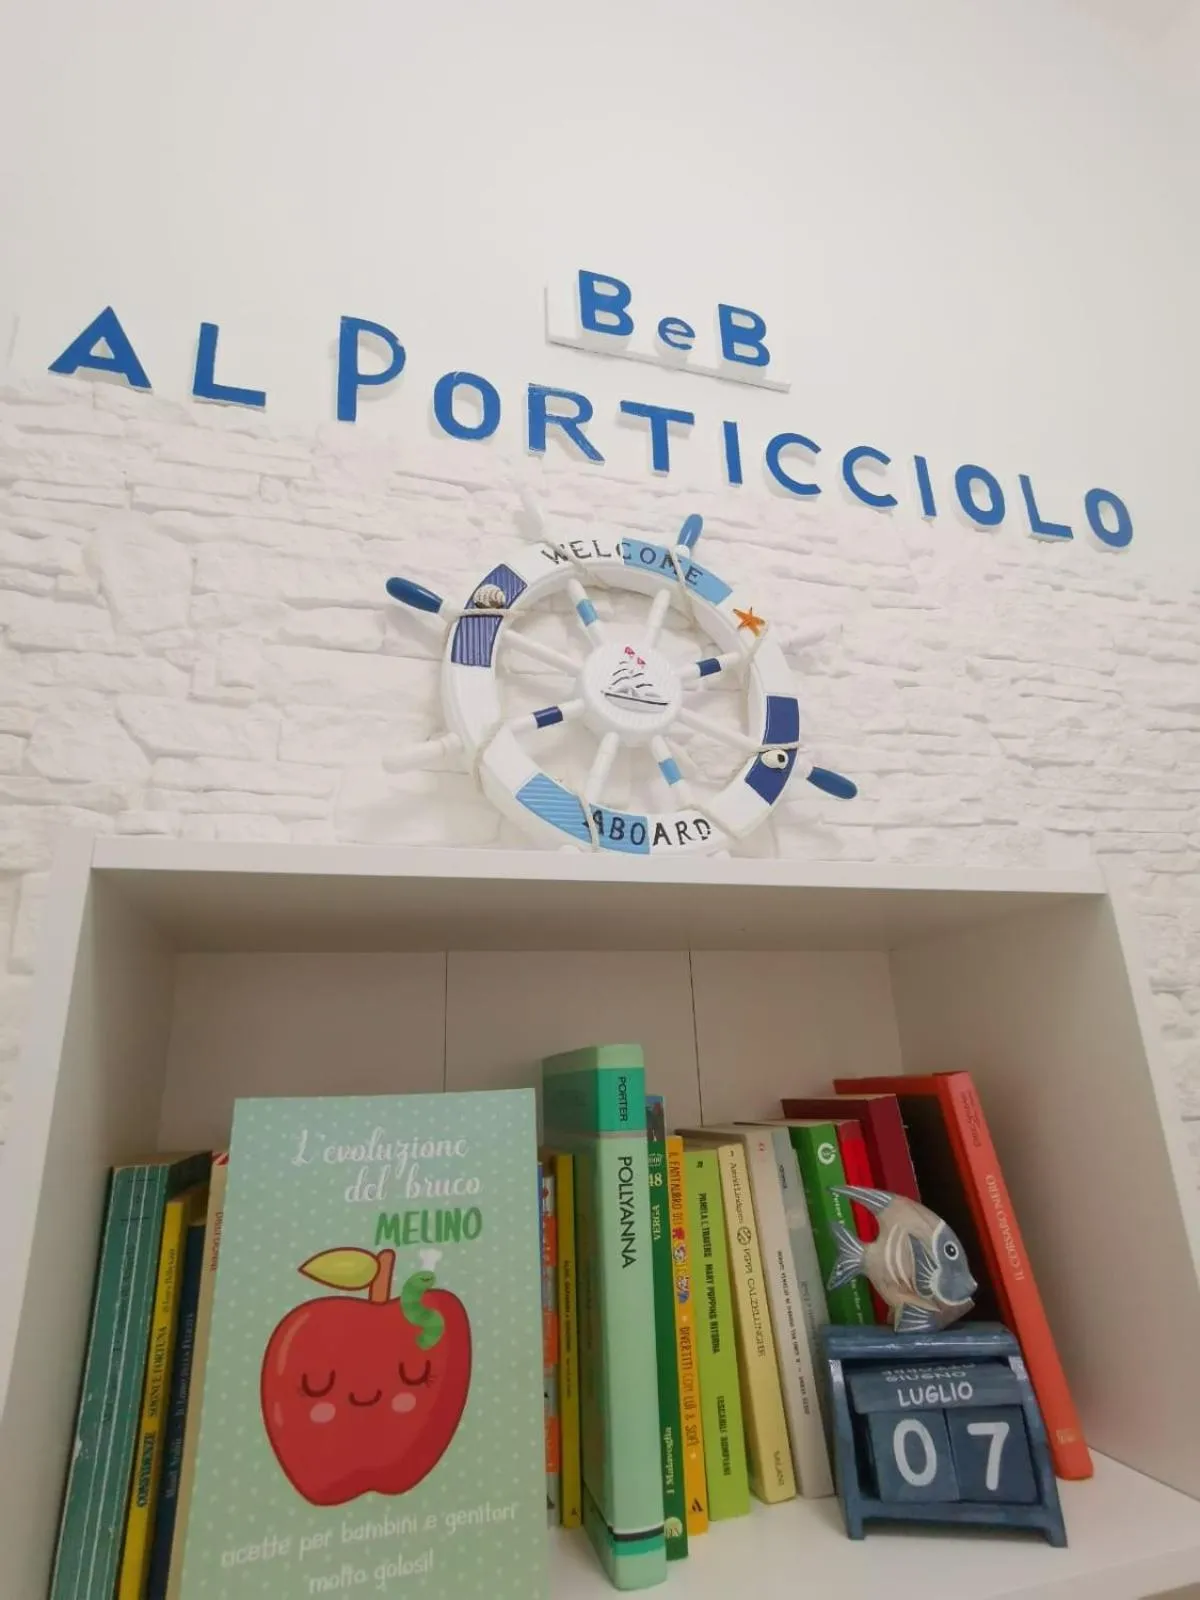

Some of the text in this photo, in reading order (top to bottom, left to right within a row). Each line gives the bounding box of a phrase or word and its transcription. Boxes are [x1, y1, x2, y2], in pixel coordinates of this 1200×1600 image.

[578, 269, 770, 367] BeB
[47, 306, 1133, 549] AL PORTICCIOLO
[541, 539, 704, 586] WELCOME
[582, 809, 711, 846] ABOARD
[617, 1075, 628, 1123] PORTER
[344, 1164, 483, 1202] del bruco
[618, 1155, 637, 1269] POLLYANNA
[652, 1204, 660, 1240] VERGA
[697, 1193, 708, 1219] PAMELA
[375, 1207, 483, 1247] MELINO
[704, 1264, 714, 1283] MARY
[706, 1286, 717, 1319] POPPINS
[897, 1381, 973, 1407] LUGLIO
[664, 1426, 673, 1485] Malavoglia
[299, 1530, 333, 1561] per
[341, 1513, 418, 1544] bambini
[424, 1513, 437, 1530] e
[445, 1501, 519, 1535] genitori
[309, 1566, 368, 1594] molto
